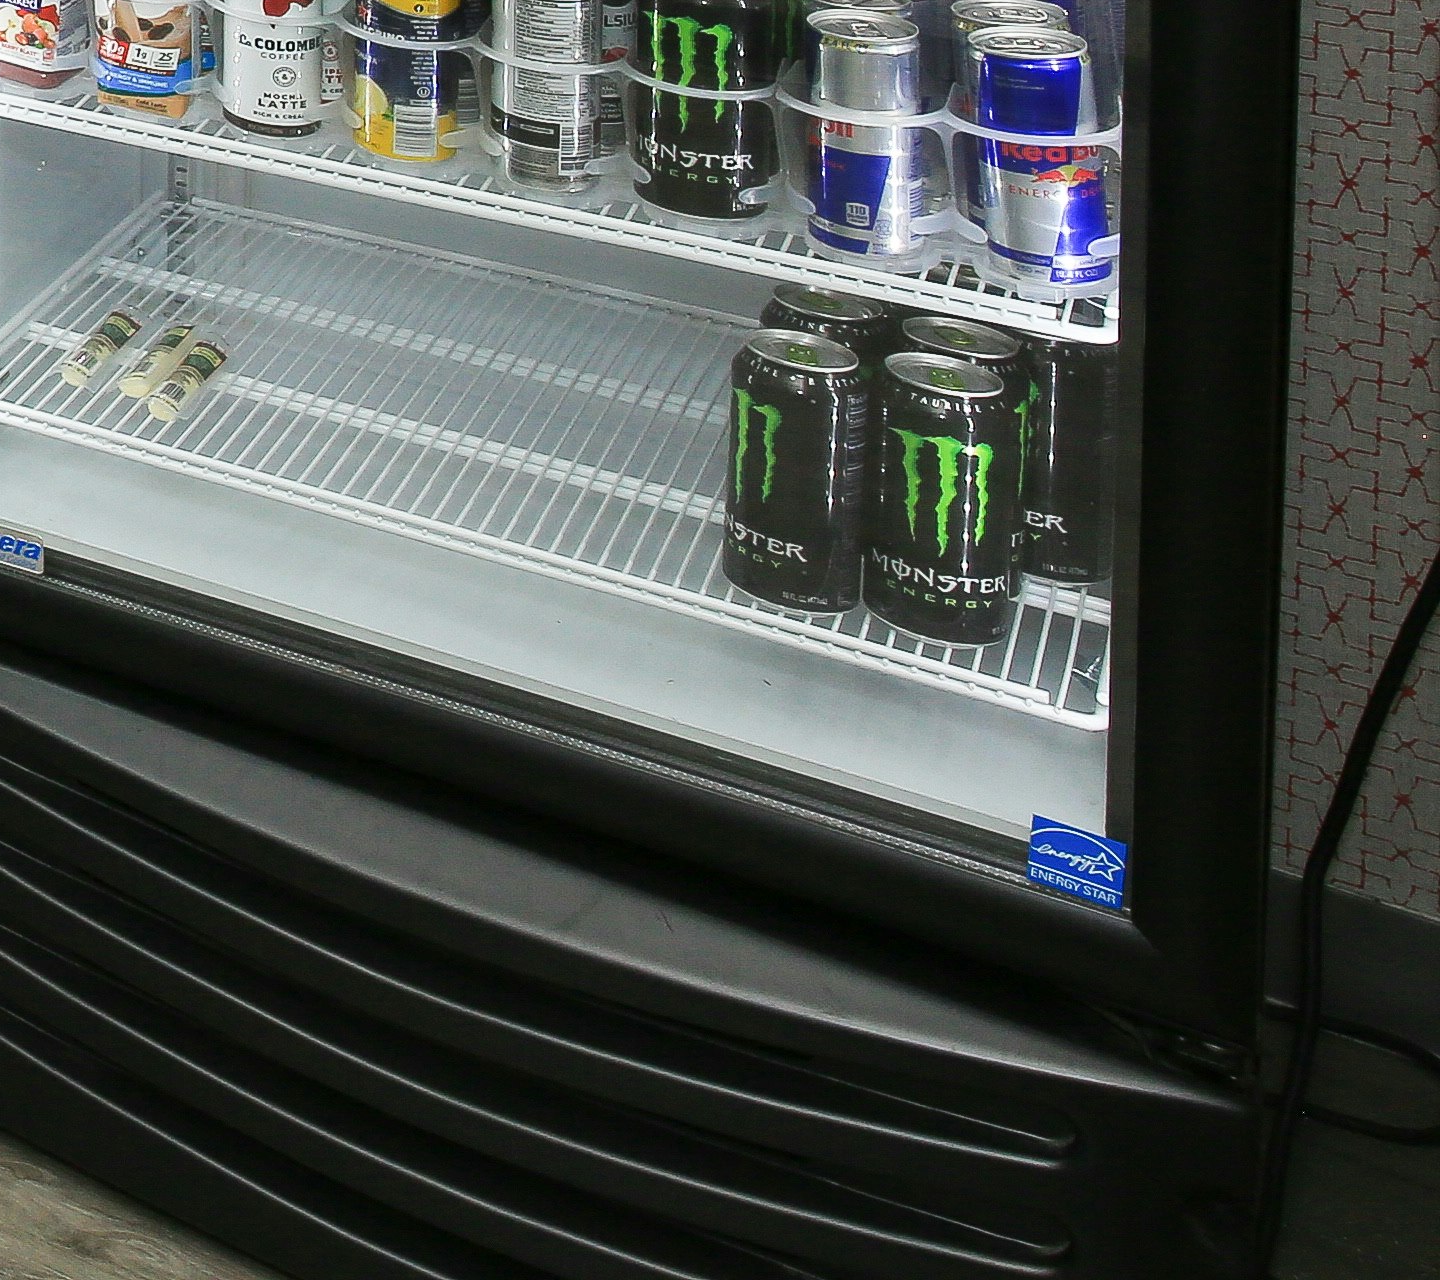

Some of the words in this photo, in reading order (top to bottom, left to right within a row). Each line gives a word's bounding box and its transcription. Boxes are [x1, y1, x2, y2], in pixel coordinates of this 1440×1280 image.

[1, 42, 20, 52] BERRY
[21, 45, 38, 57] BLAST
[135, 47, 147, 59] 1g
[260, 52, 305, 61] COFFEE
[158, 52, 173, 62] 25
[257, 99, 307, 110] LATTE
[848, 204, 867, 217] 110
[909, 392, 982, 414] TAURINE
[872, 548, 1007, 594] MONSTER
[886, 579, 992, 609] ENERGY
[1031, 868, 1081, 892] ENERGY
[1083, 884, 1118, 905] STAR
